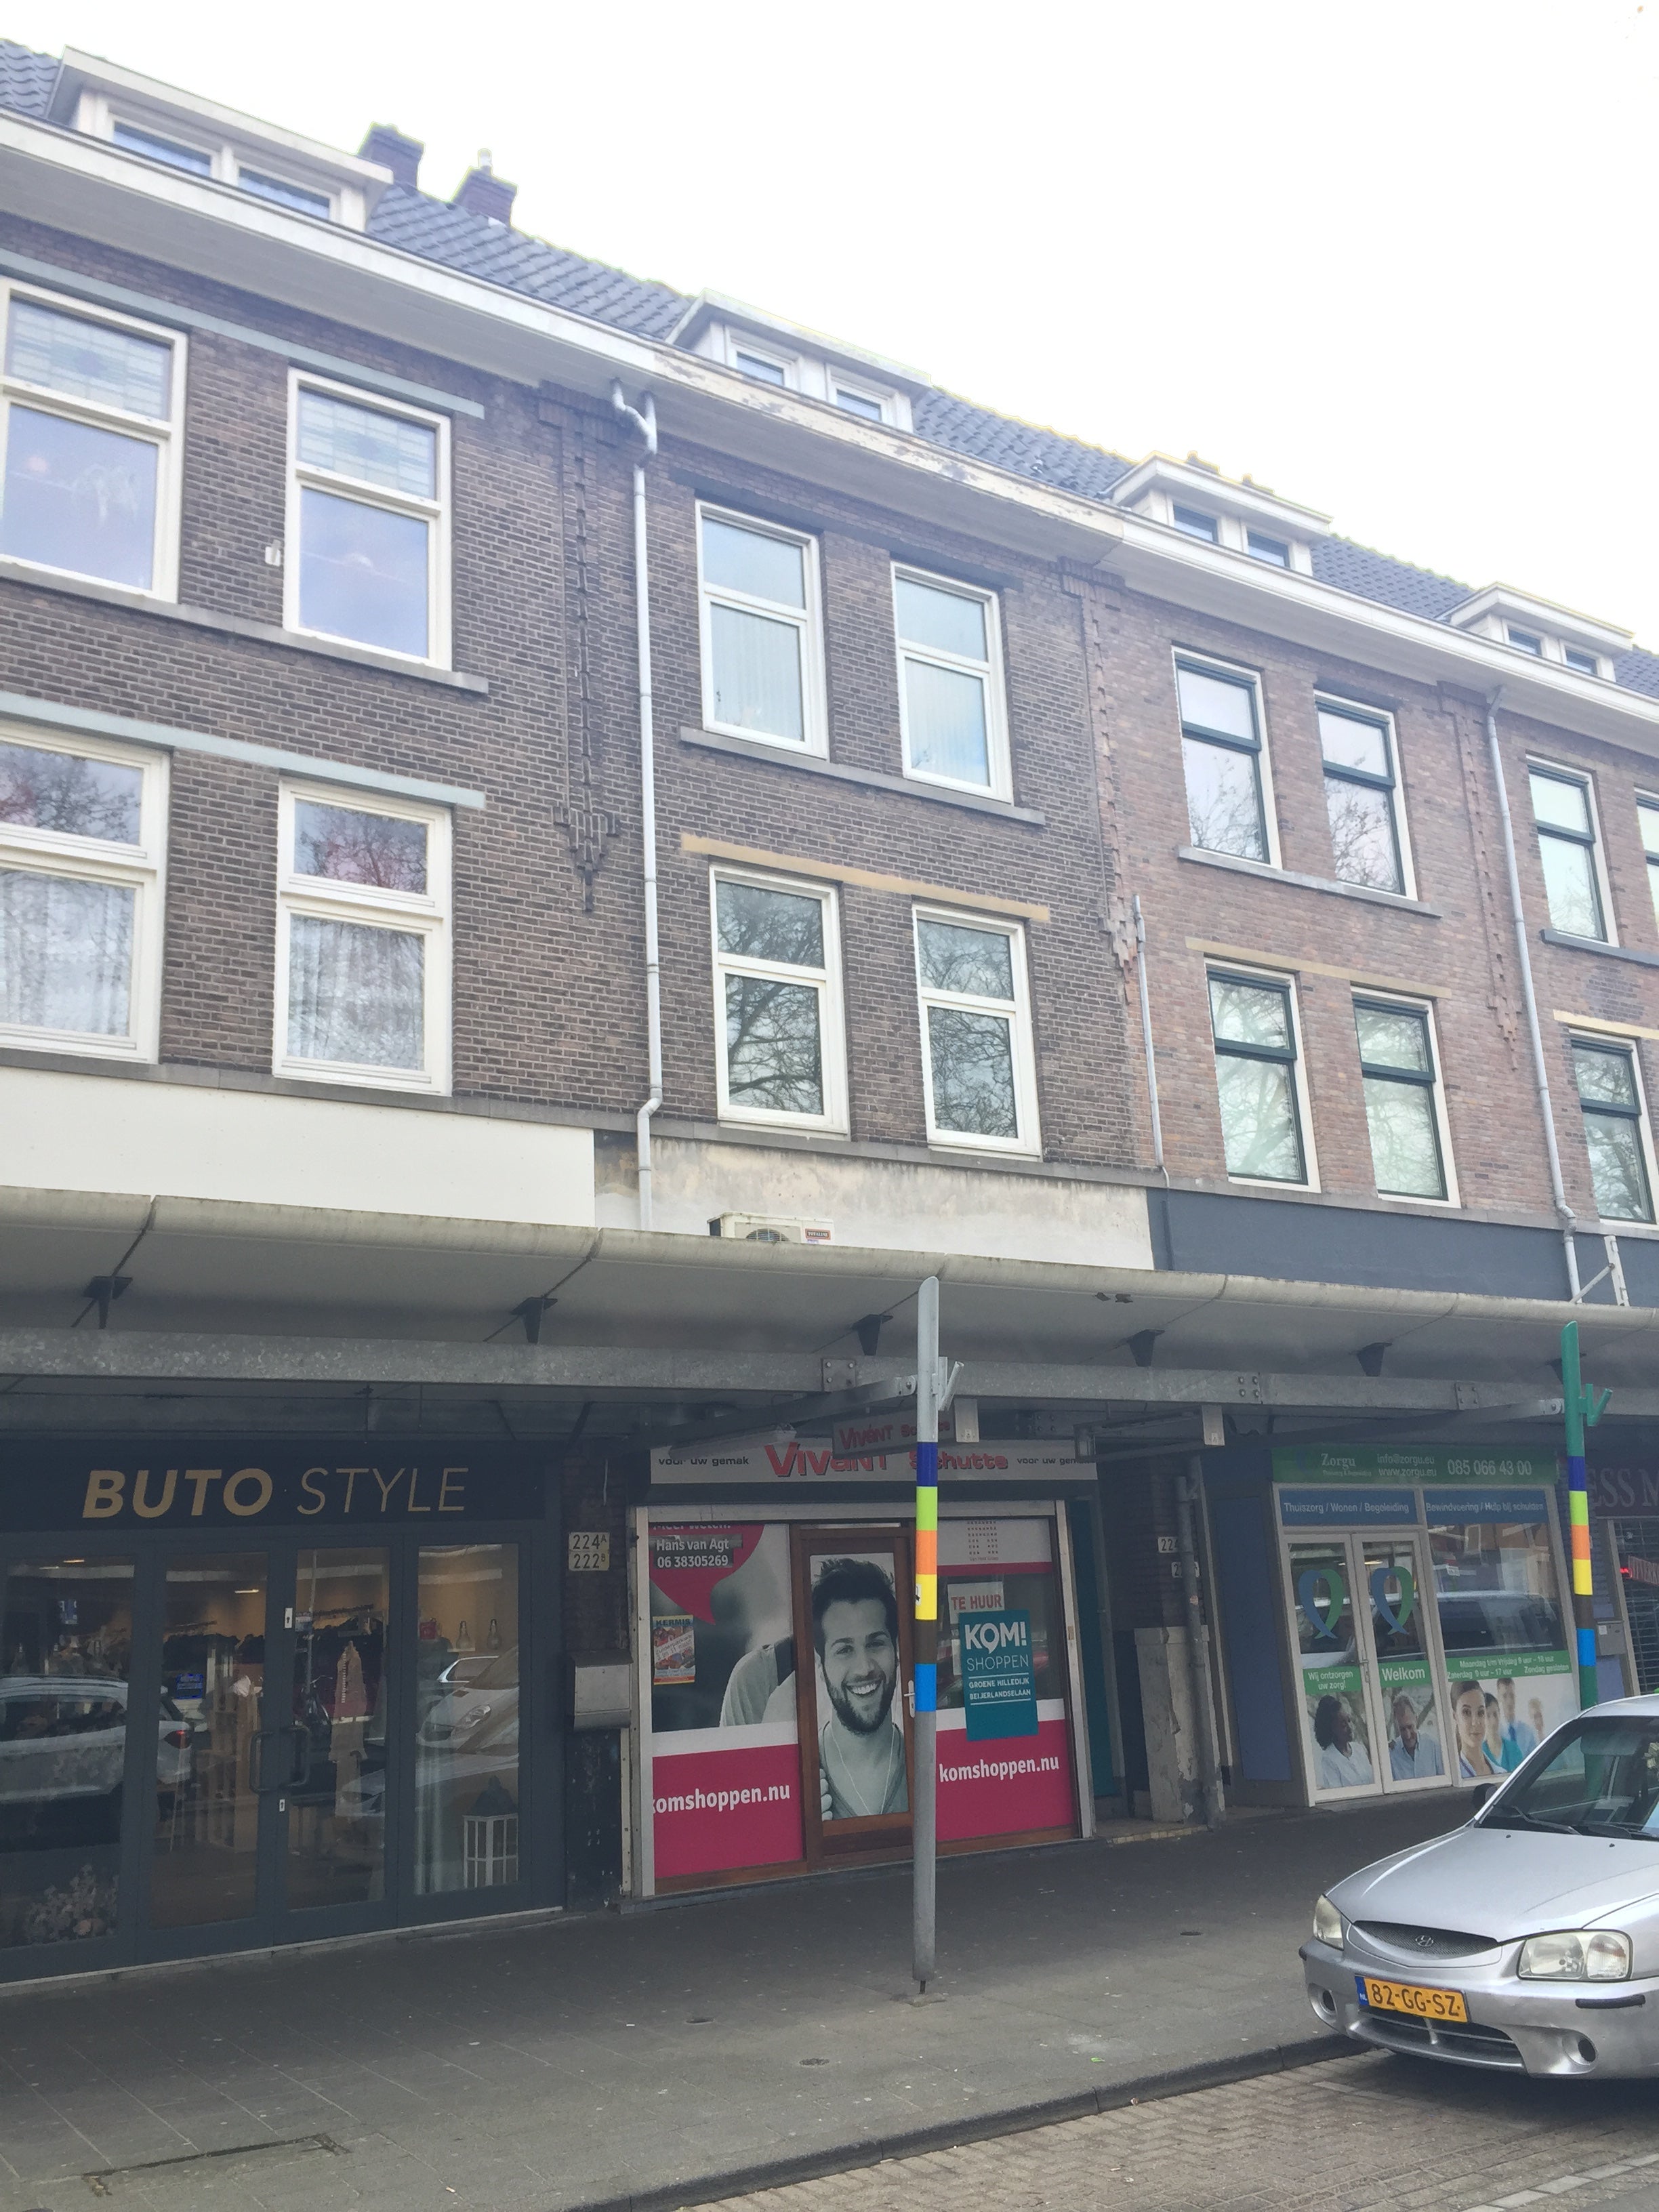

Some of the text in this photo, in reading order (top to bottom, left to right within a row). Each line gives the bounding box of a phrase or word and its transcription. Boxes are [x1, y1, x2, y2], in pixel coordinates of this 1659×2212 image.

[712, 1456, 750, 1467] gemak
[1321, 1453, 1356, 1470] Zorgu
[1377, 1453, 1435, 1466] info@zorgu.eu
[1448, 1459, 1532, 1475] 085 066 43 00
[82, 1467, 469, 1518] BUTO STYLE
[1284, 1502, 1324, 1514] Thuiszorg
[656, 1538, 729, 1553] Hans van Agt
[657, 1555, 729, 1568] 06 38305269
[951, 1594, 1002, 1610] TE HUUR
[964, 1621, 1027, 1654] KOM!
[966, 1654, 1029, 1672] SHOPPEN
[1308, 1670, 1353, 1681] Wij ontzorgen
[1382, 1667, 1425, 1681] Welkom
[969, 1677, 1029, 1689] GROENE HILLEDIJK
[970, 1689, 1031, 1700] BEIJERLANDSELAAN
[939, 1757, 1059, 1782] komshoppen.nu
[1372, 1983, 1459, 2017] 82-GG-SZ
